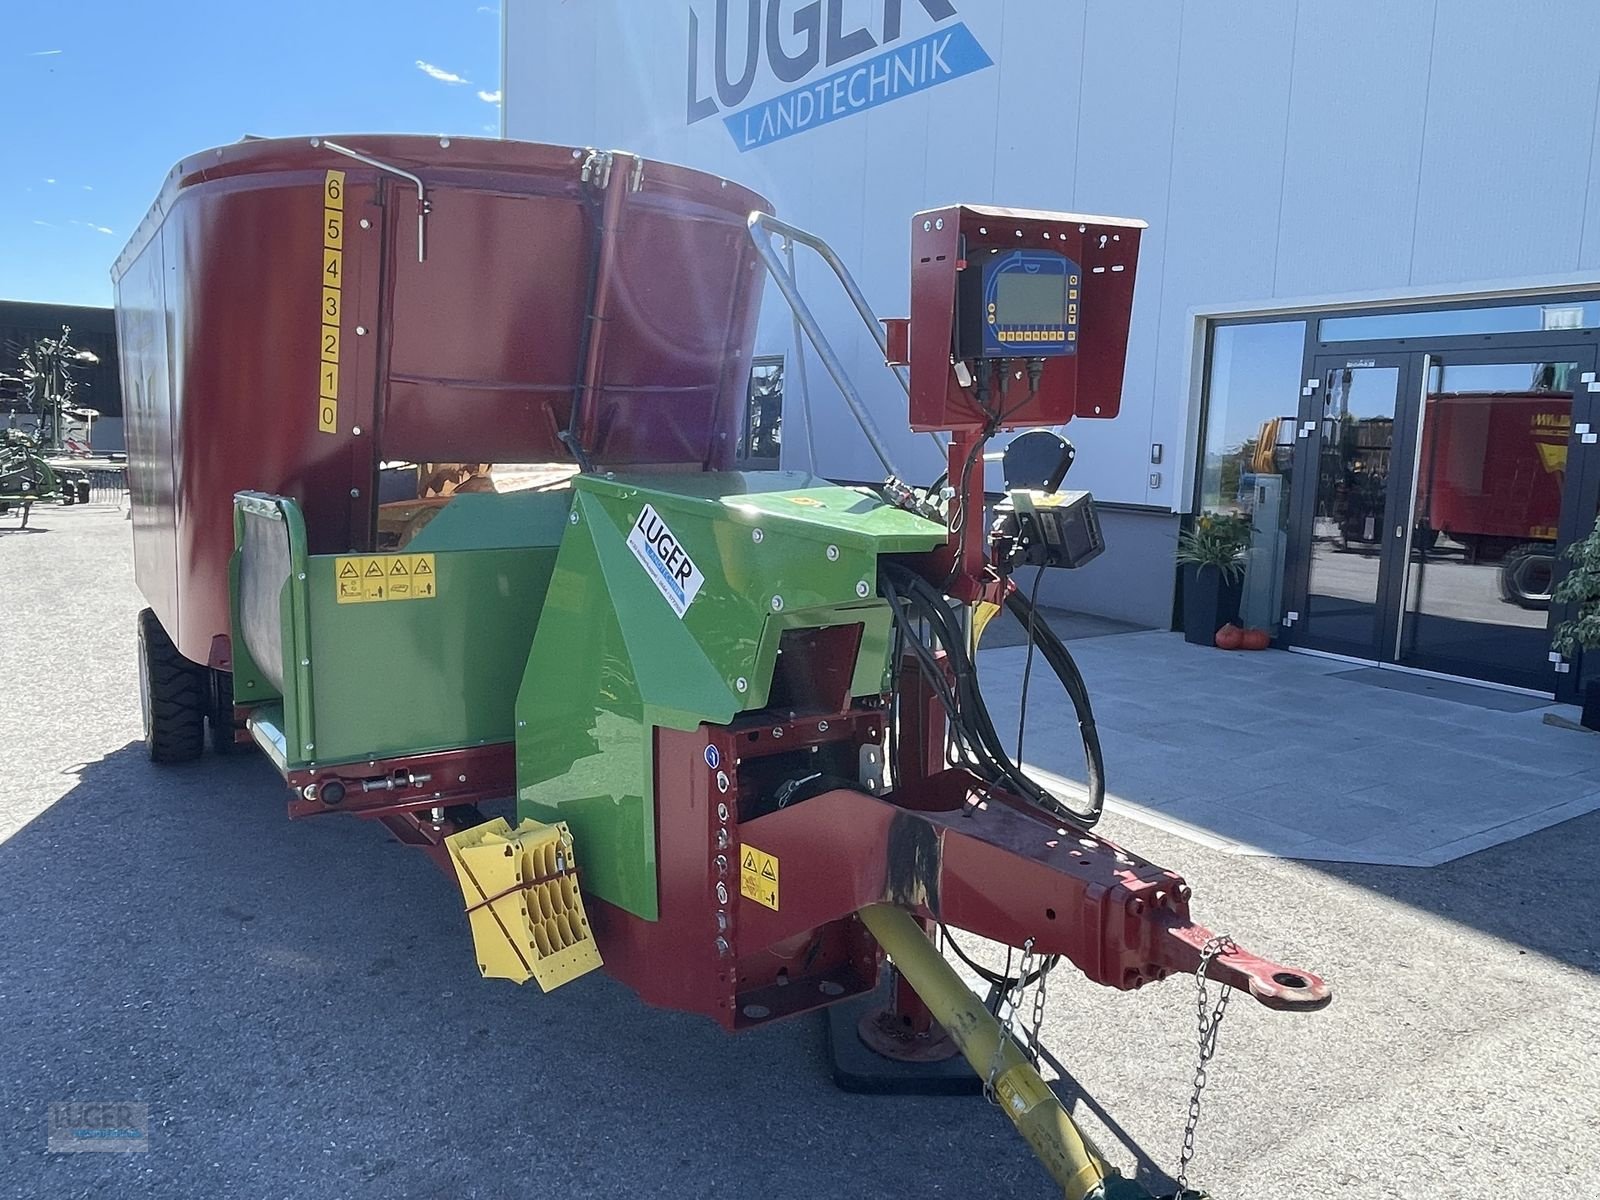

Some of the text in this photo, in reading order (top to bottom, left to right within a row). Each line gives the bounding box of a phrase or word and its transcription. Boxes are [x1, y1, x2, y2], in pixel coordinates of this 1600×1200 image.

[744, 33, 952, 146] LANDTECHNIK
[328, 179, 340, 200] 6
[327, 219, 340, 239] 5
[326, 258, 339, 279] 4
[326, 297, 337, 316] 3
[324, 335, 336, 354] 2
[325, 372, 333, 391] 1
[322, 407, 334, 425] 0
[637, 506, 692, 590] LUGER
